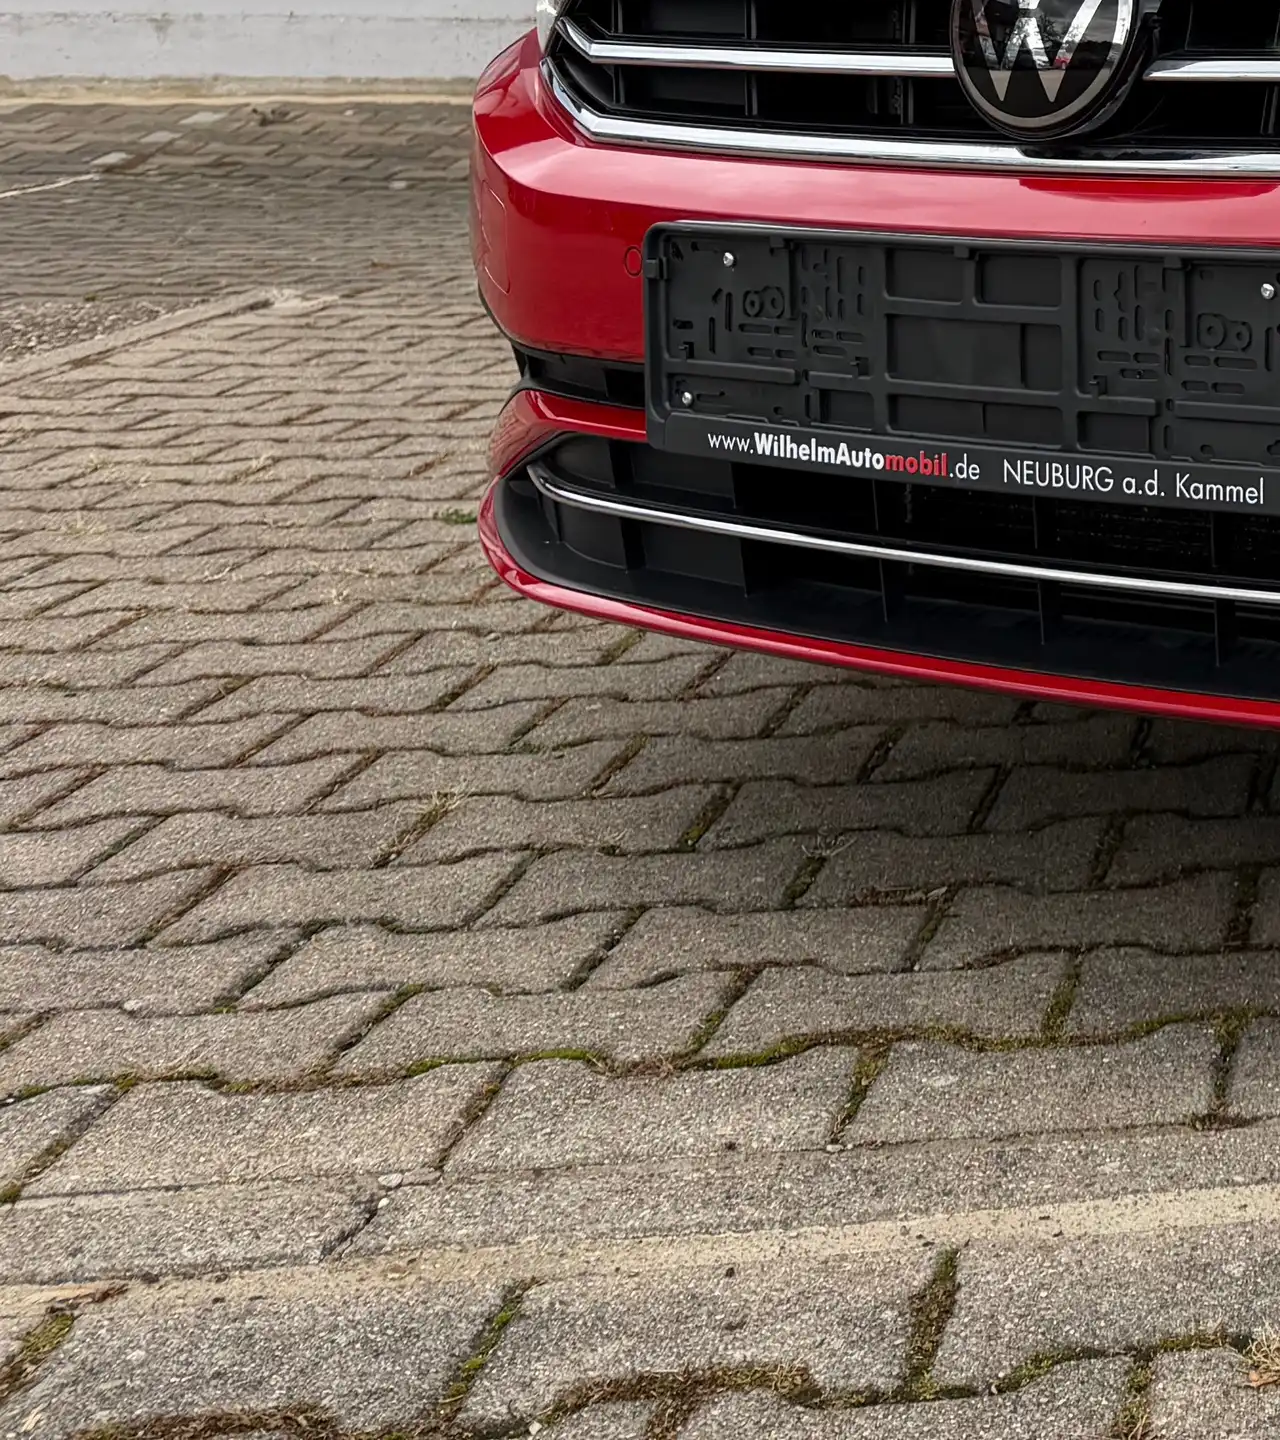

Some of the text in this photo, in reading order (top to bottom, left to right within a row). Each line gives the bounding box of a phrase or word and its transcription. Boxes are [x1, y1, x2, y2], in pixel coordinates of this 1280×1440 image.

[707, 431, 1265, 505] www.WilhelmAutomobil.de NEUBURG a.d. Kammel
